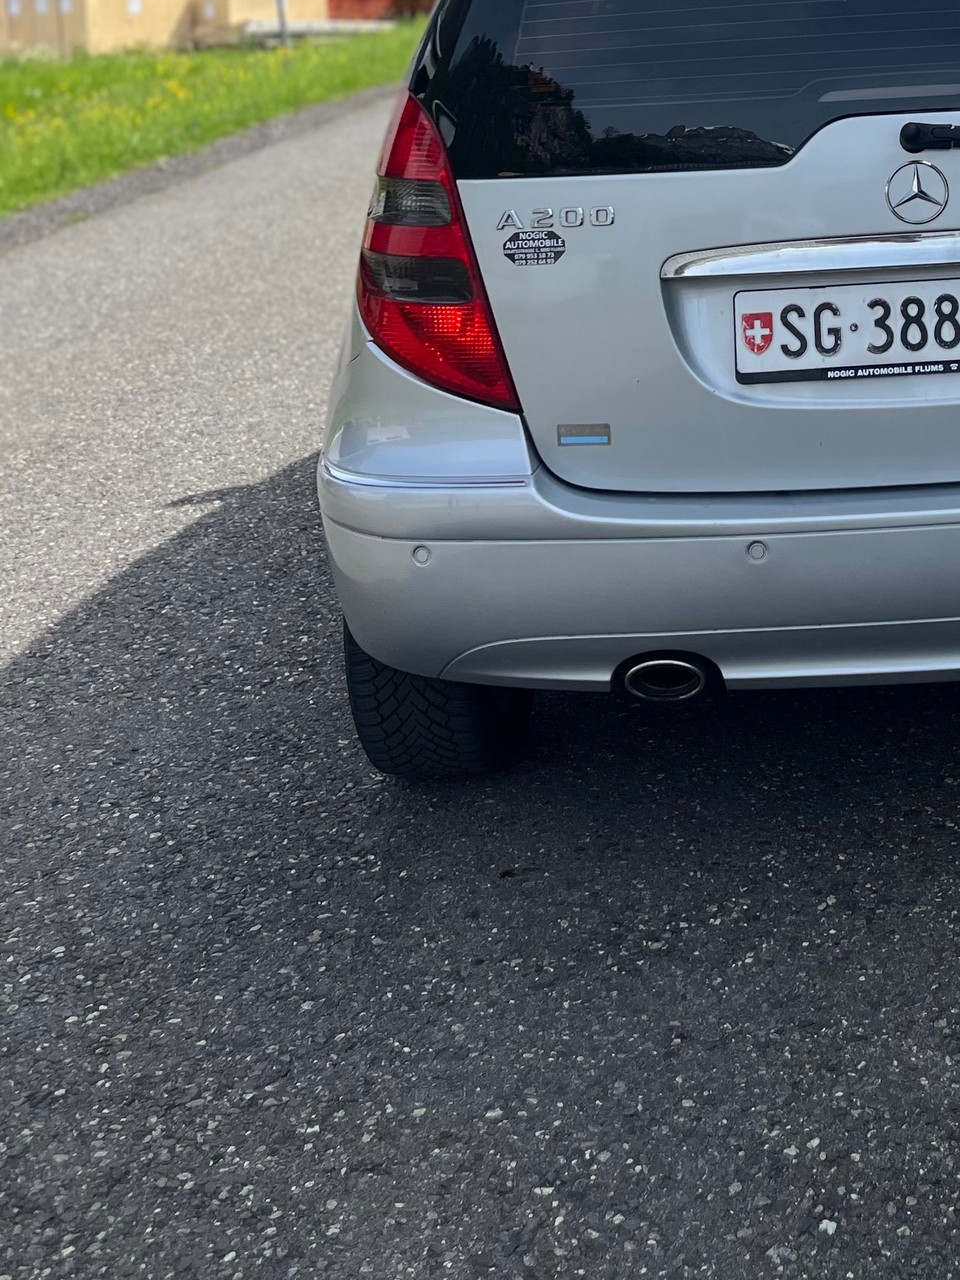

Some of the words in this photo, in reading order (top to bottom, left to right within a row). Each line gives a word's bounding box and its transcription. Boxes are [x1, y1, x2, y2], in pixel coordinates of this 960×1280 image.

[519, 231, 548, 240] NOGIC
[505, 239, 564, 249] AUTOMOBILE
[827, 369, 855, 378] NOGIC
[857, 366, 913, 376] AUTOMOBILE
[914, 364, 944, 373] FLUMS
